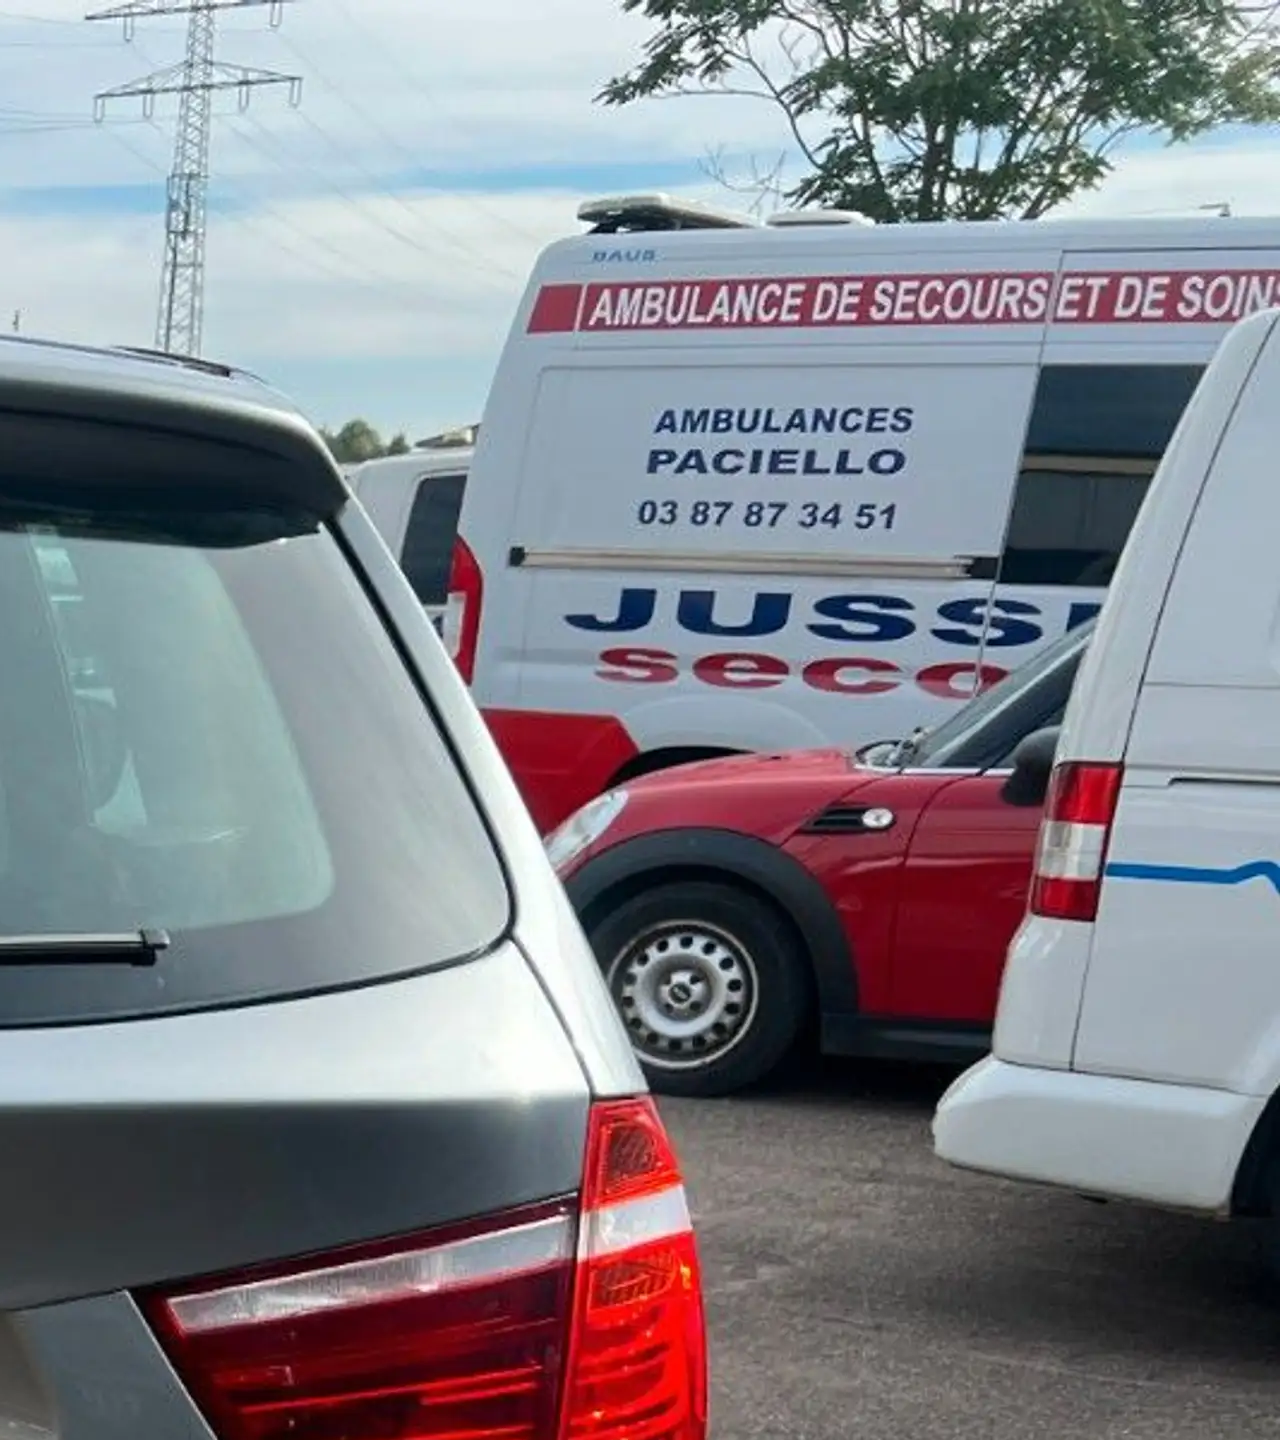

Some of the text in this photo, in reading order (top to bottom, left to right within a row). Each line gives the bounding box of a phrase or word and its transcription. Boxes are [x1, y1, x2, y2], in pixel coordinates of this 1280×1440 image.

[589, 283, 806, 326] AMBULANCE
[811, 281, 864, 322] DE
[869, 277, 1049, 321] SECOURS
[1056, 276, 1111, 319] ET
[1113, 276, 1171, 318] DE
[654, 407, 914, 434] AMBULANCES
[646, 449, 907, 475] PACIELLO
[638, 500, 897, 529] 03 87 87 34 51
